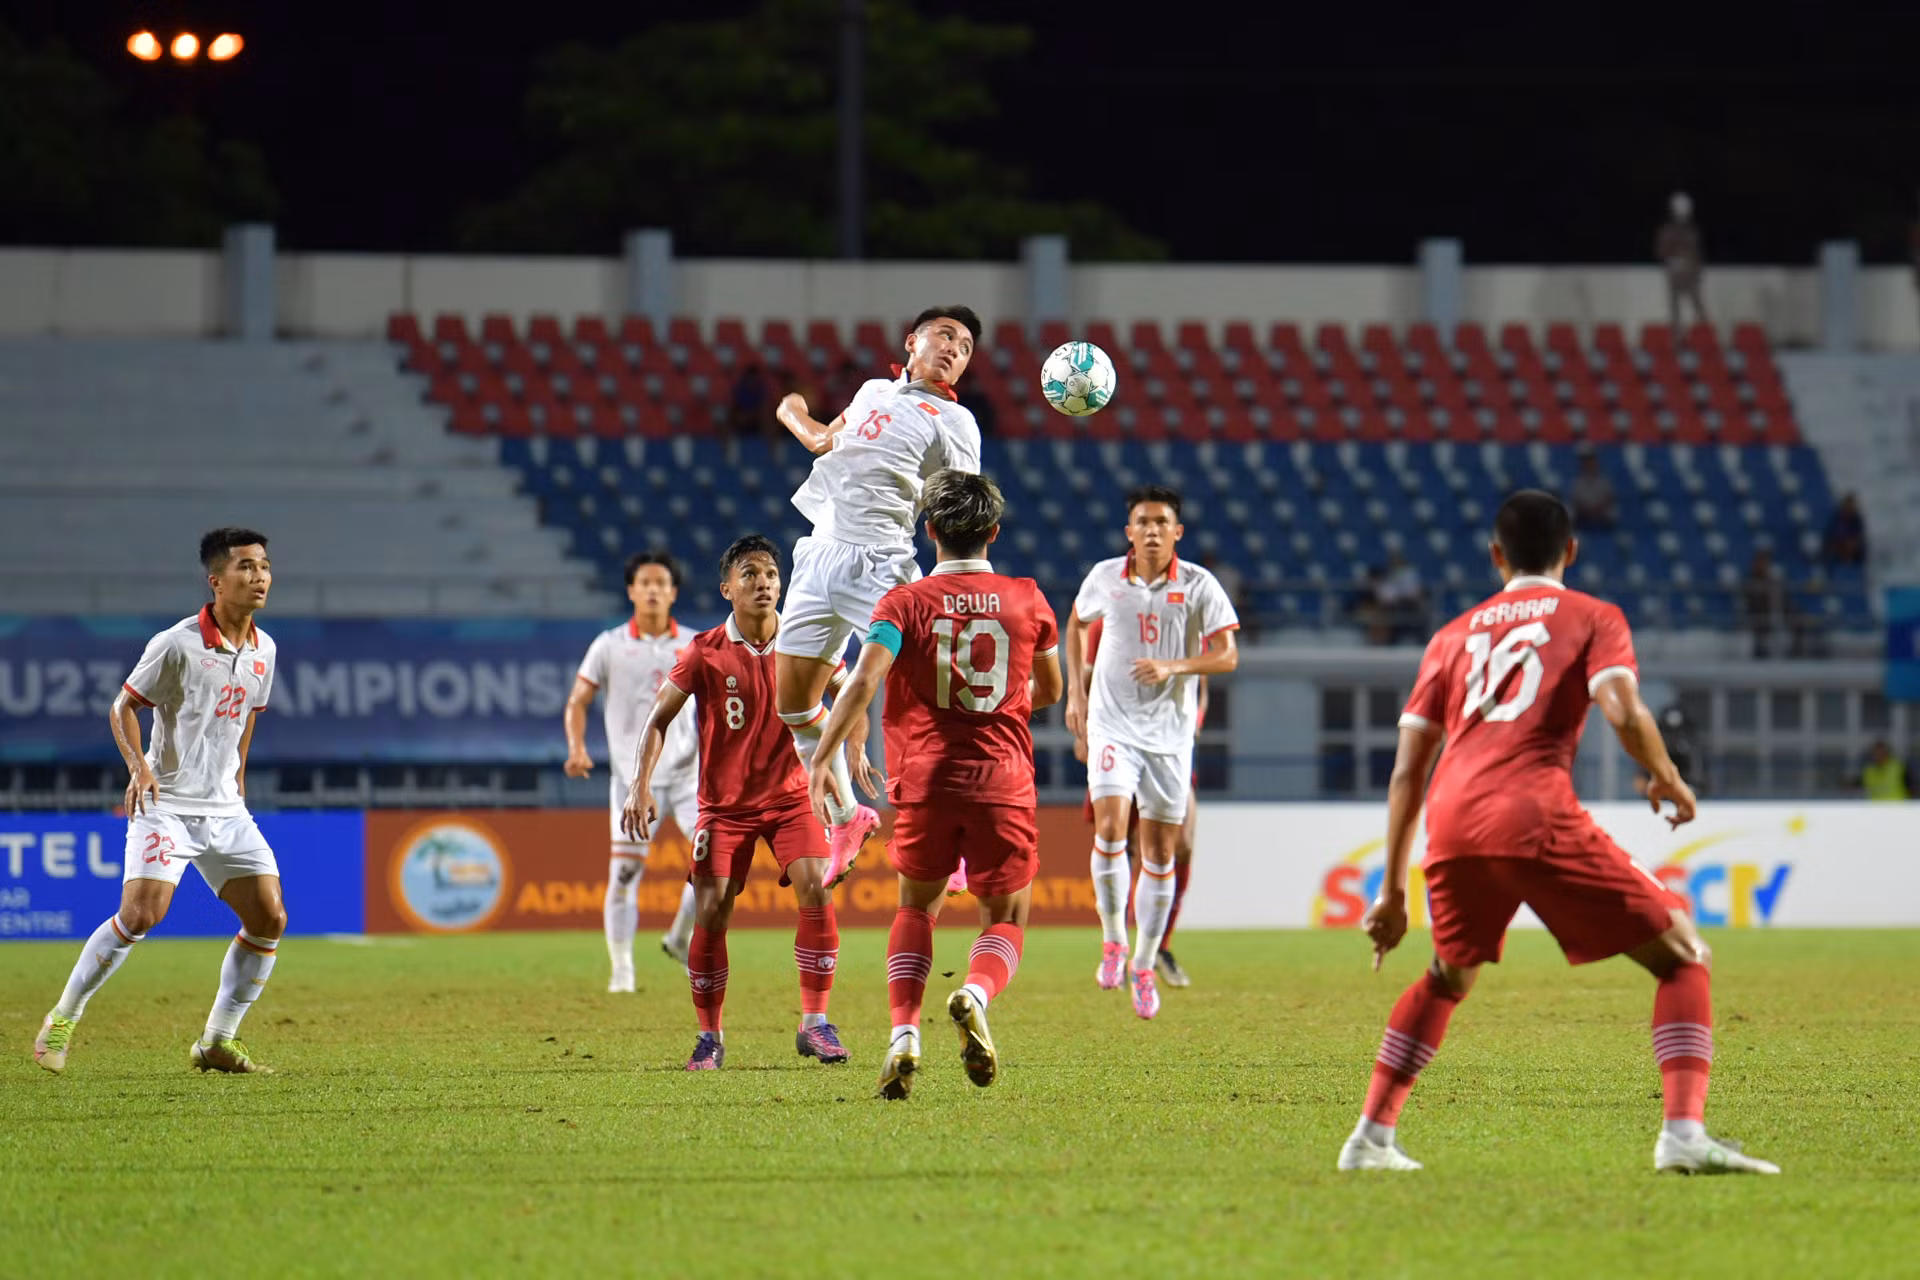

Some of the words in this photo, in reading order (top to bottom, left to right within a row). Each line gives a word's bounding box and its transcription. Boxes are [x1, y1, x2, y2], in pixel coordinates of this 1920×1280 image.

[857, 409, 891, 440] 15
[942, 593, 1000, 613] DEWA
[1137, 612, 1158, 644] 16
[932, 619, 1009, 712] 19
[1464, 621, 1551, 722] 16
[0, 659, 123, 718] U23
[267, 659, 576, 718] AMPIONS
[215, 684, 246, 719] 22
[725, 697, 745, 730] 8
[0, 832, 120, 878] TEL
[142, 832, 175, 866] 22
[692, 829, 709, 861] 8
